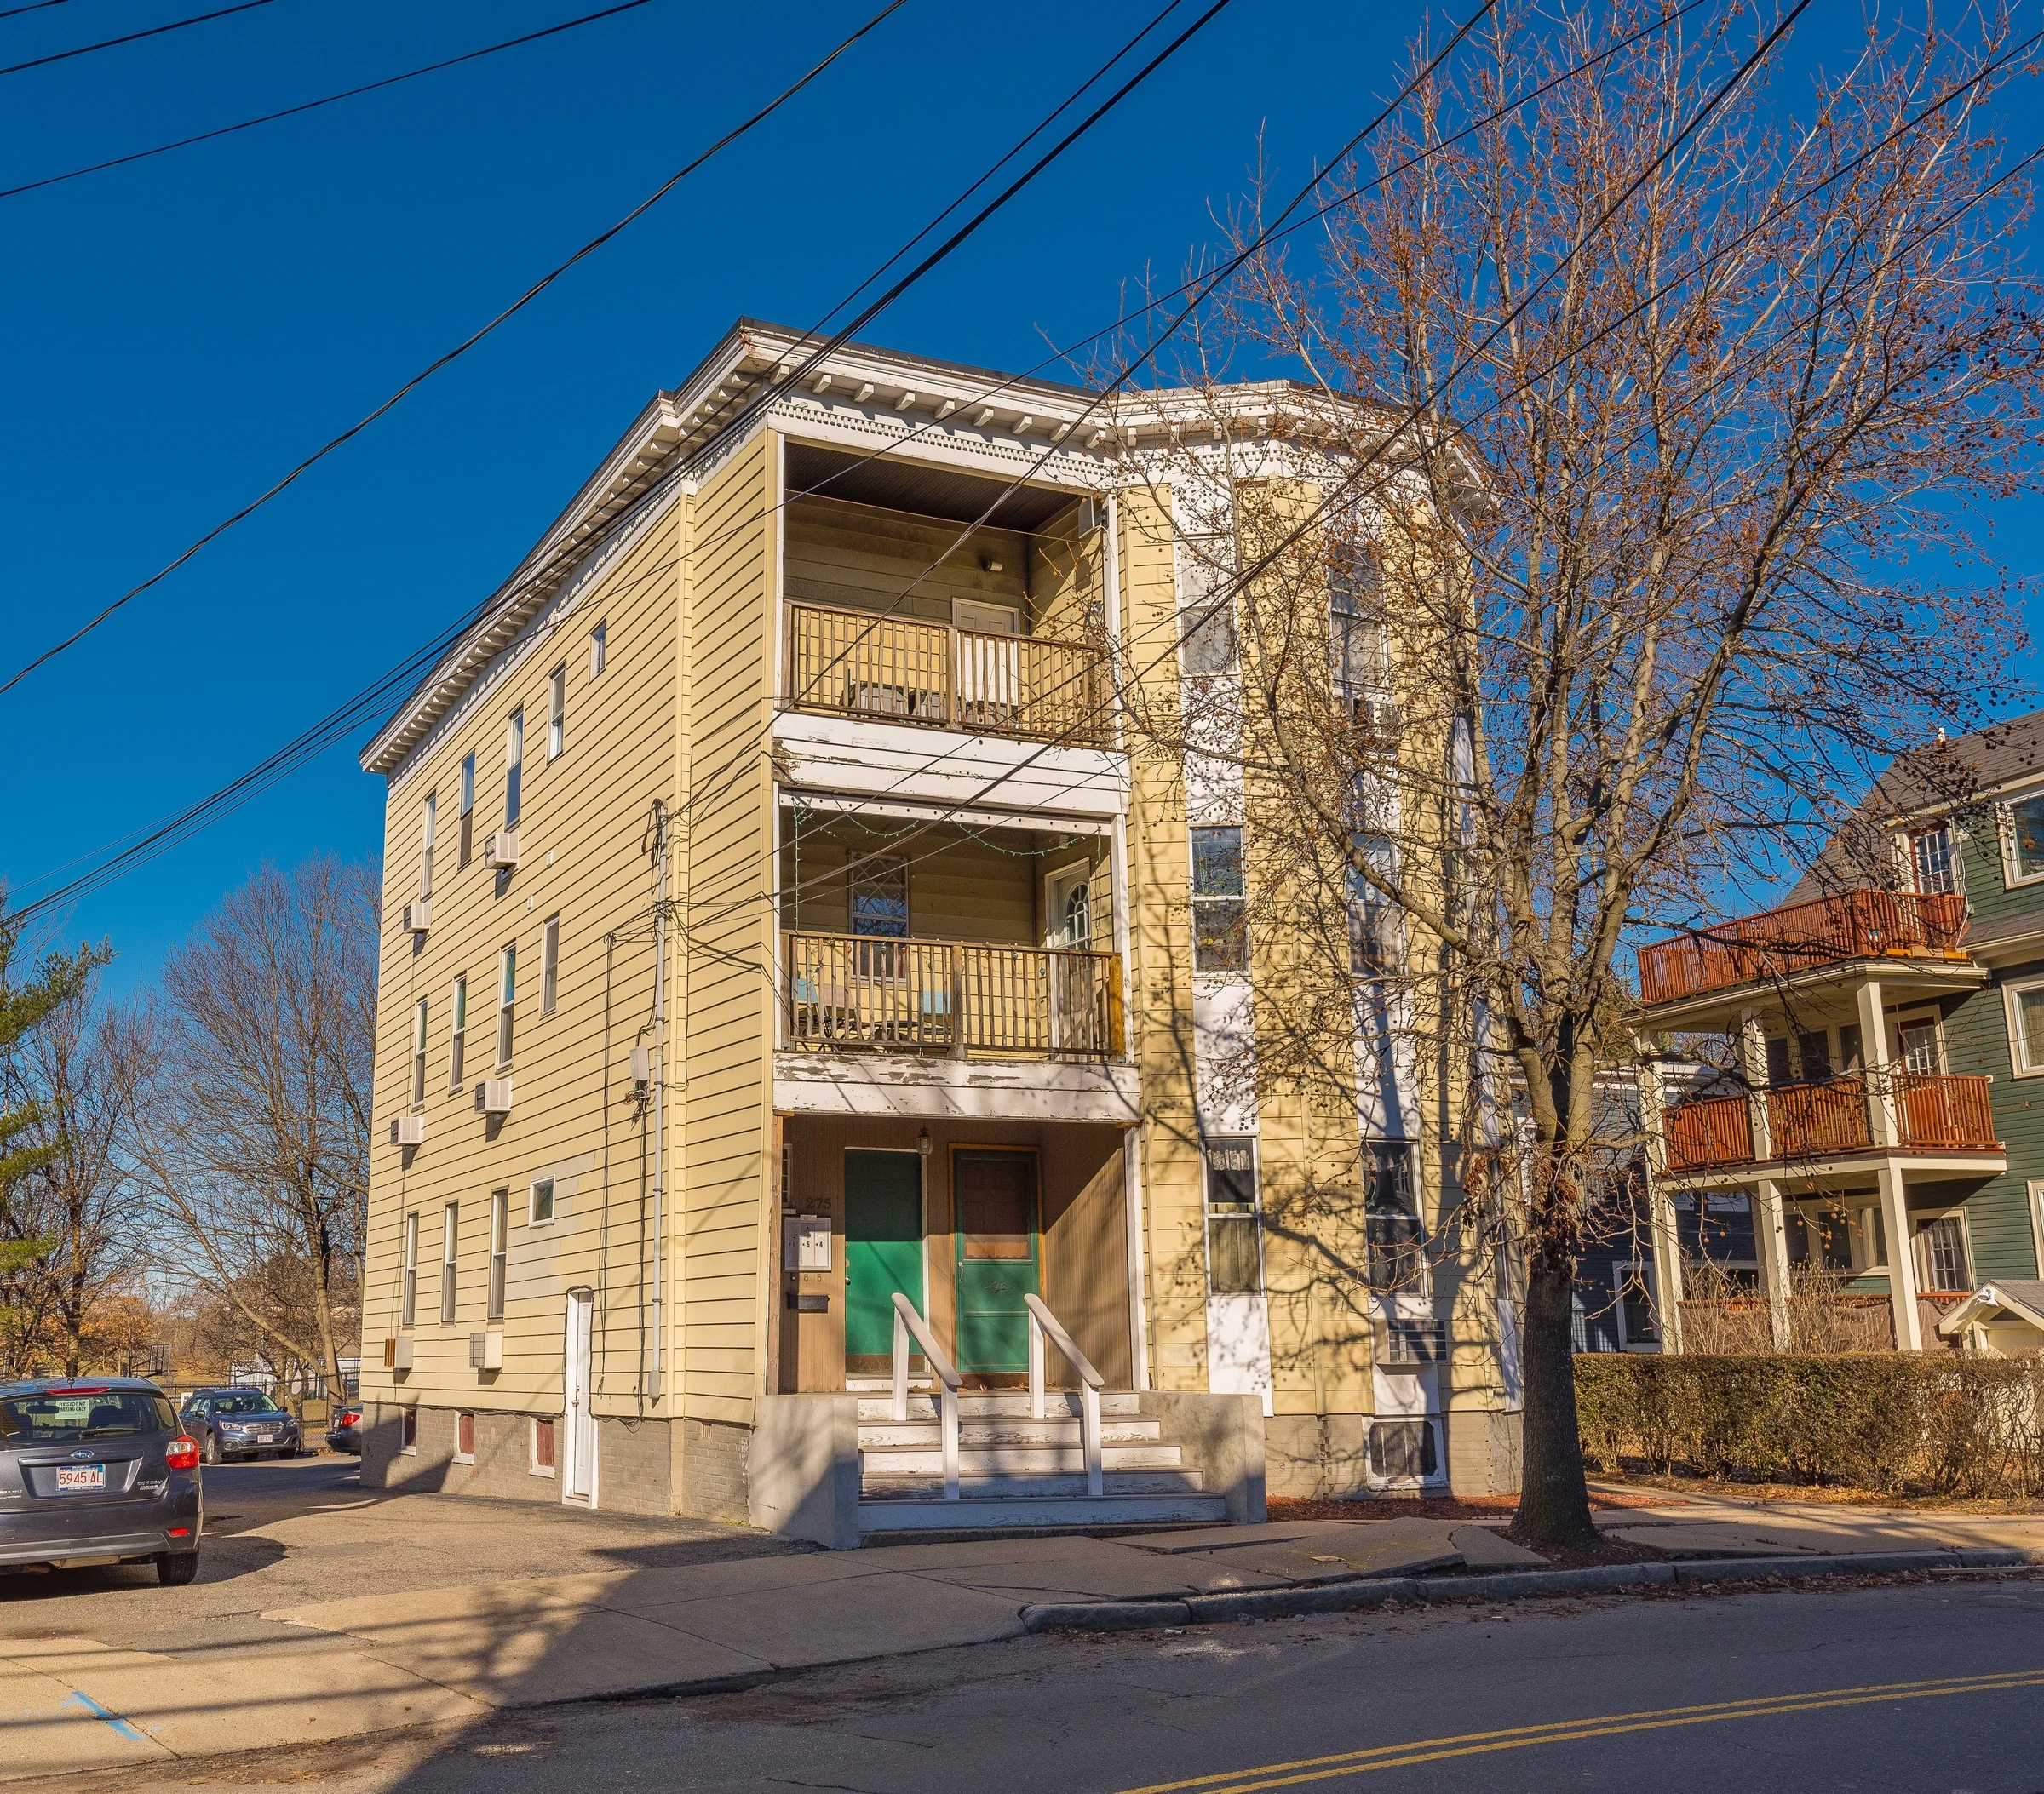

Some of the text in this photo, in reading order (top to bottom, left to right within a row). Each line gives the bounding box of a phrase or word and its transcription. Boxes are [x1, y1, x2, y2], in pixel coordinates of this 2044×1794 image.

[806, 1196, 832, 1209] 275
[60, 1471, 103, 1485] 5945 AL
